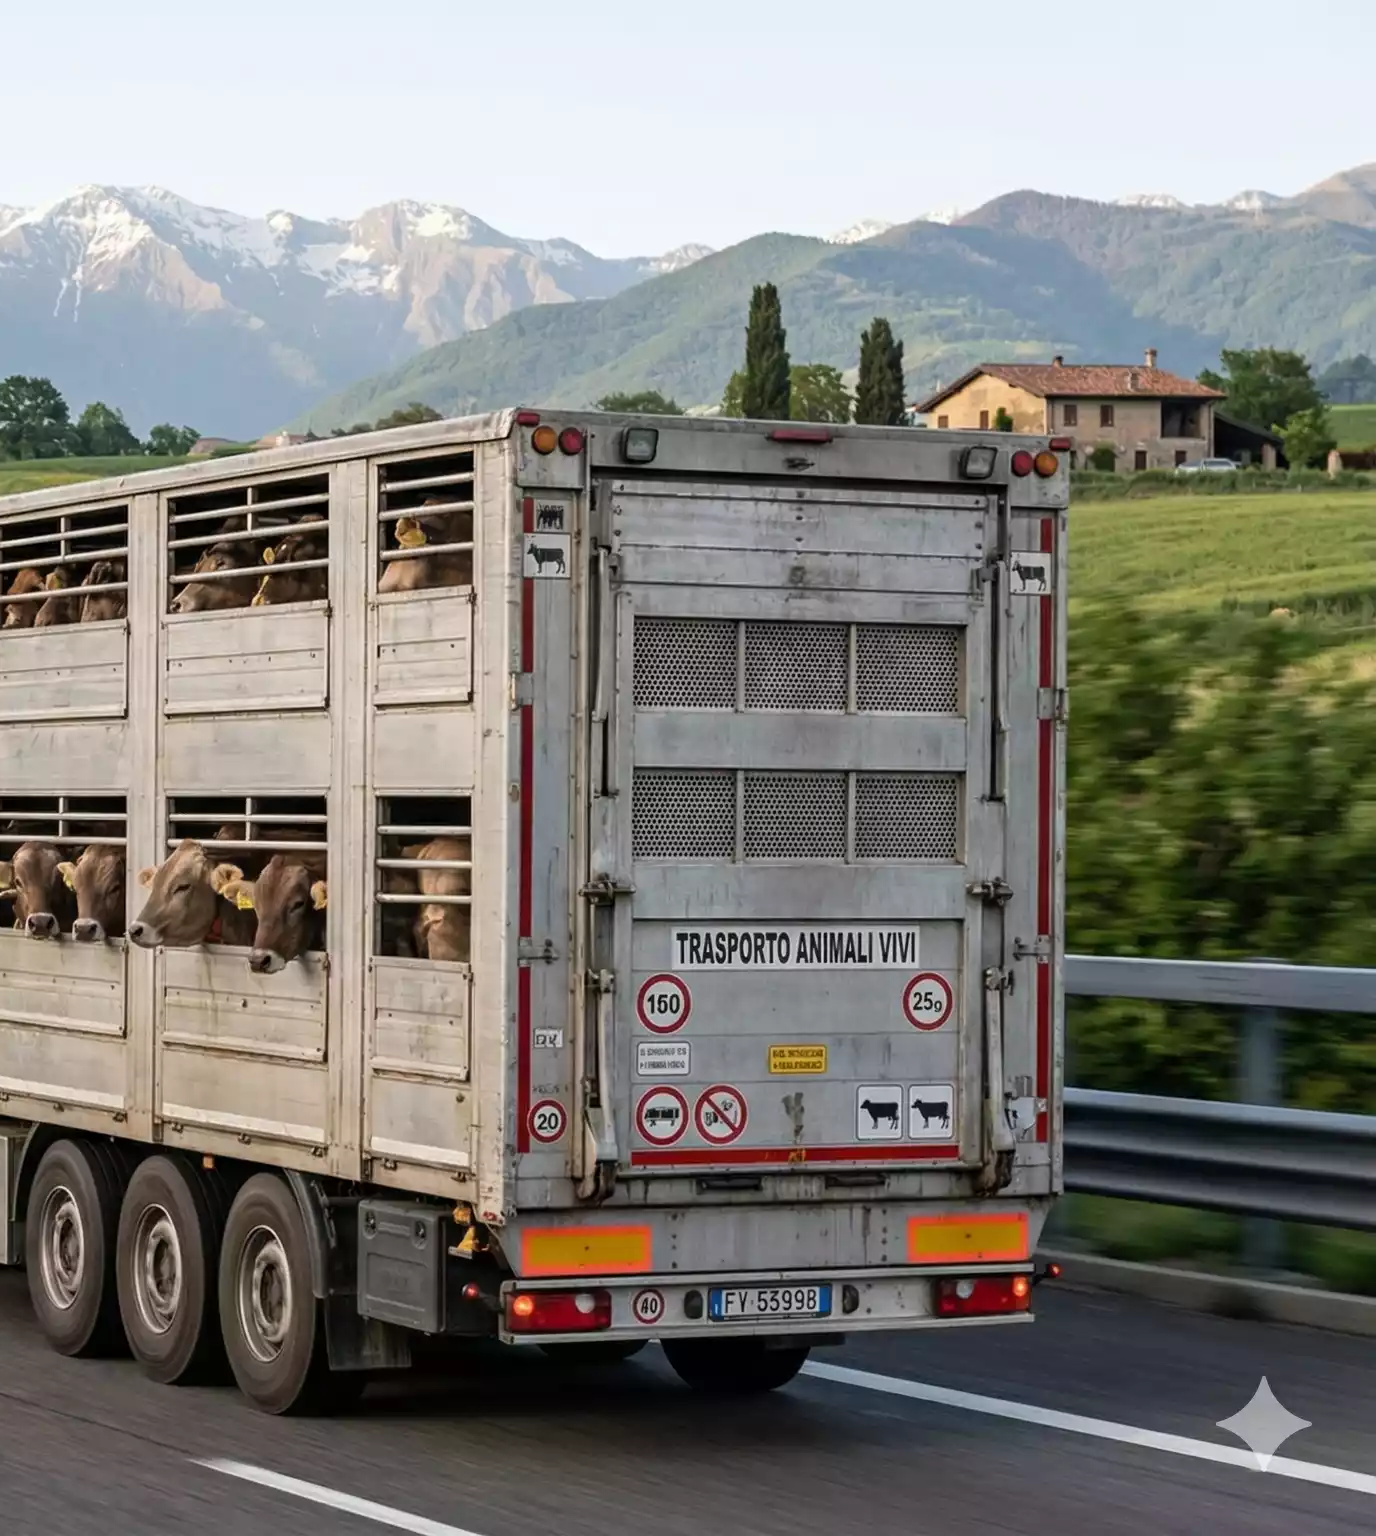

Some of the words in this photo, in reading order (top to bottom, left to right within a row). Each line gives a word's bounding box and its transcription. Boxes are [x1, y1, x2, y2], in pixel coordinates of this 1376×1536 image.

[676, 931, 791, 965] TRASPORTO
[795, 931, 873, 964] ANIMALI
[879, 931, 916, 963] VIVI
[537, 1112, 559, 1131] 20
